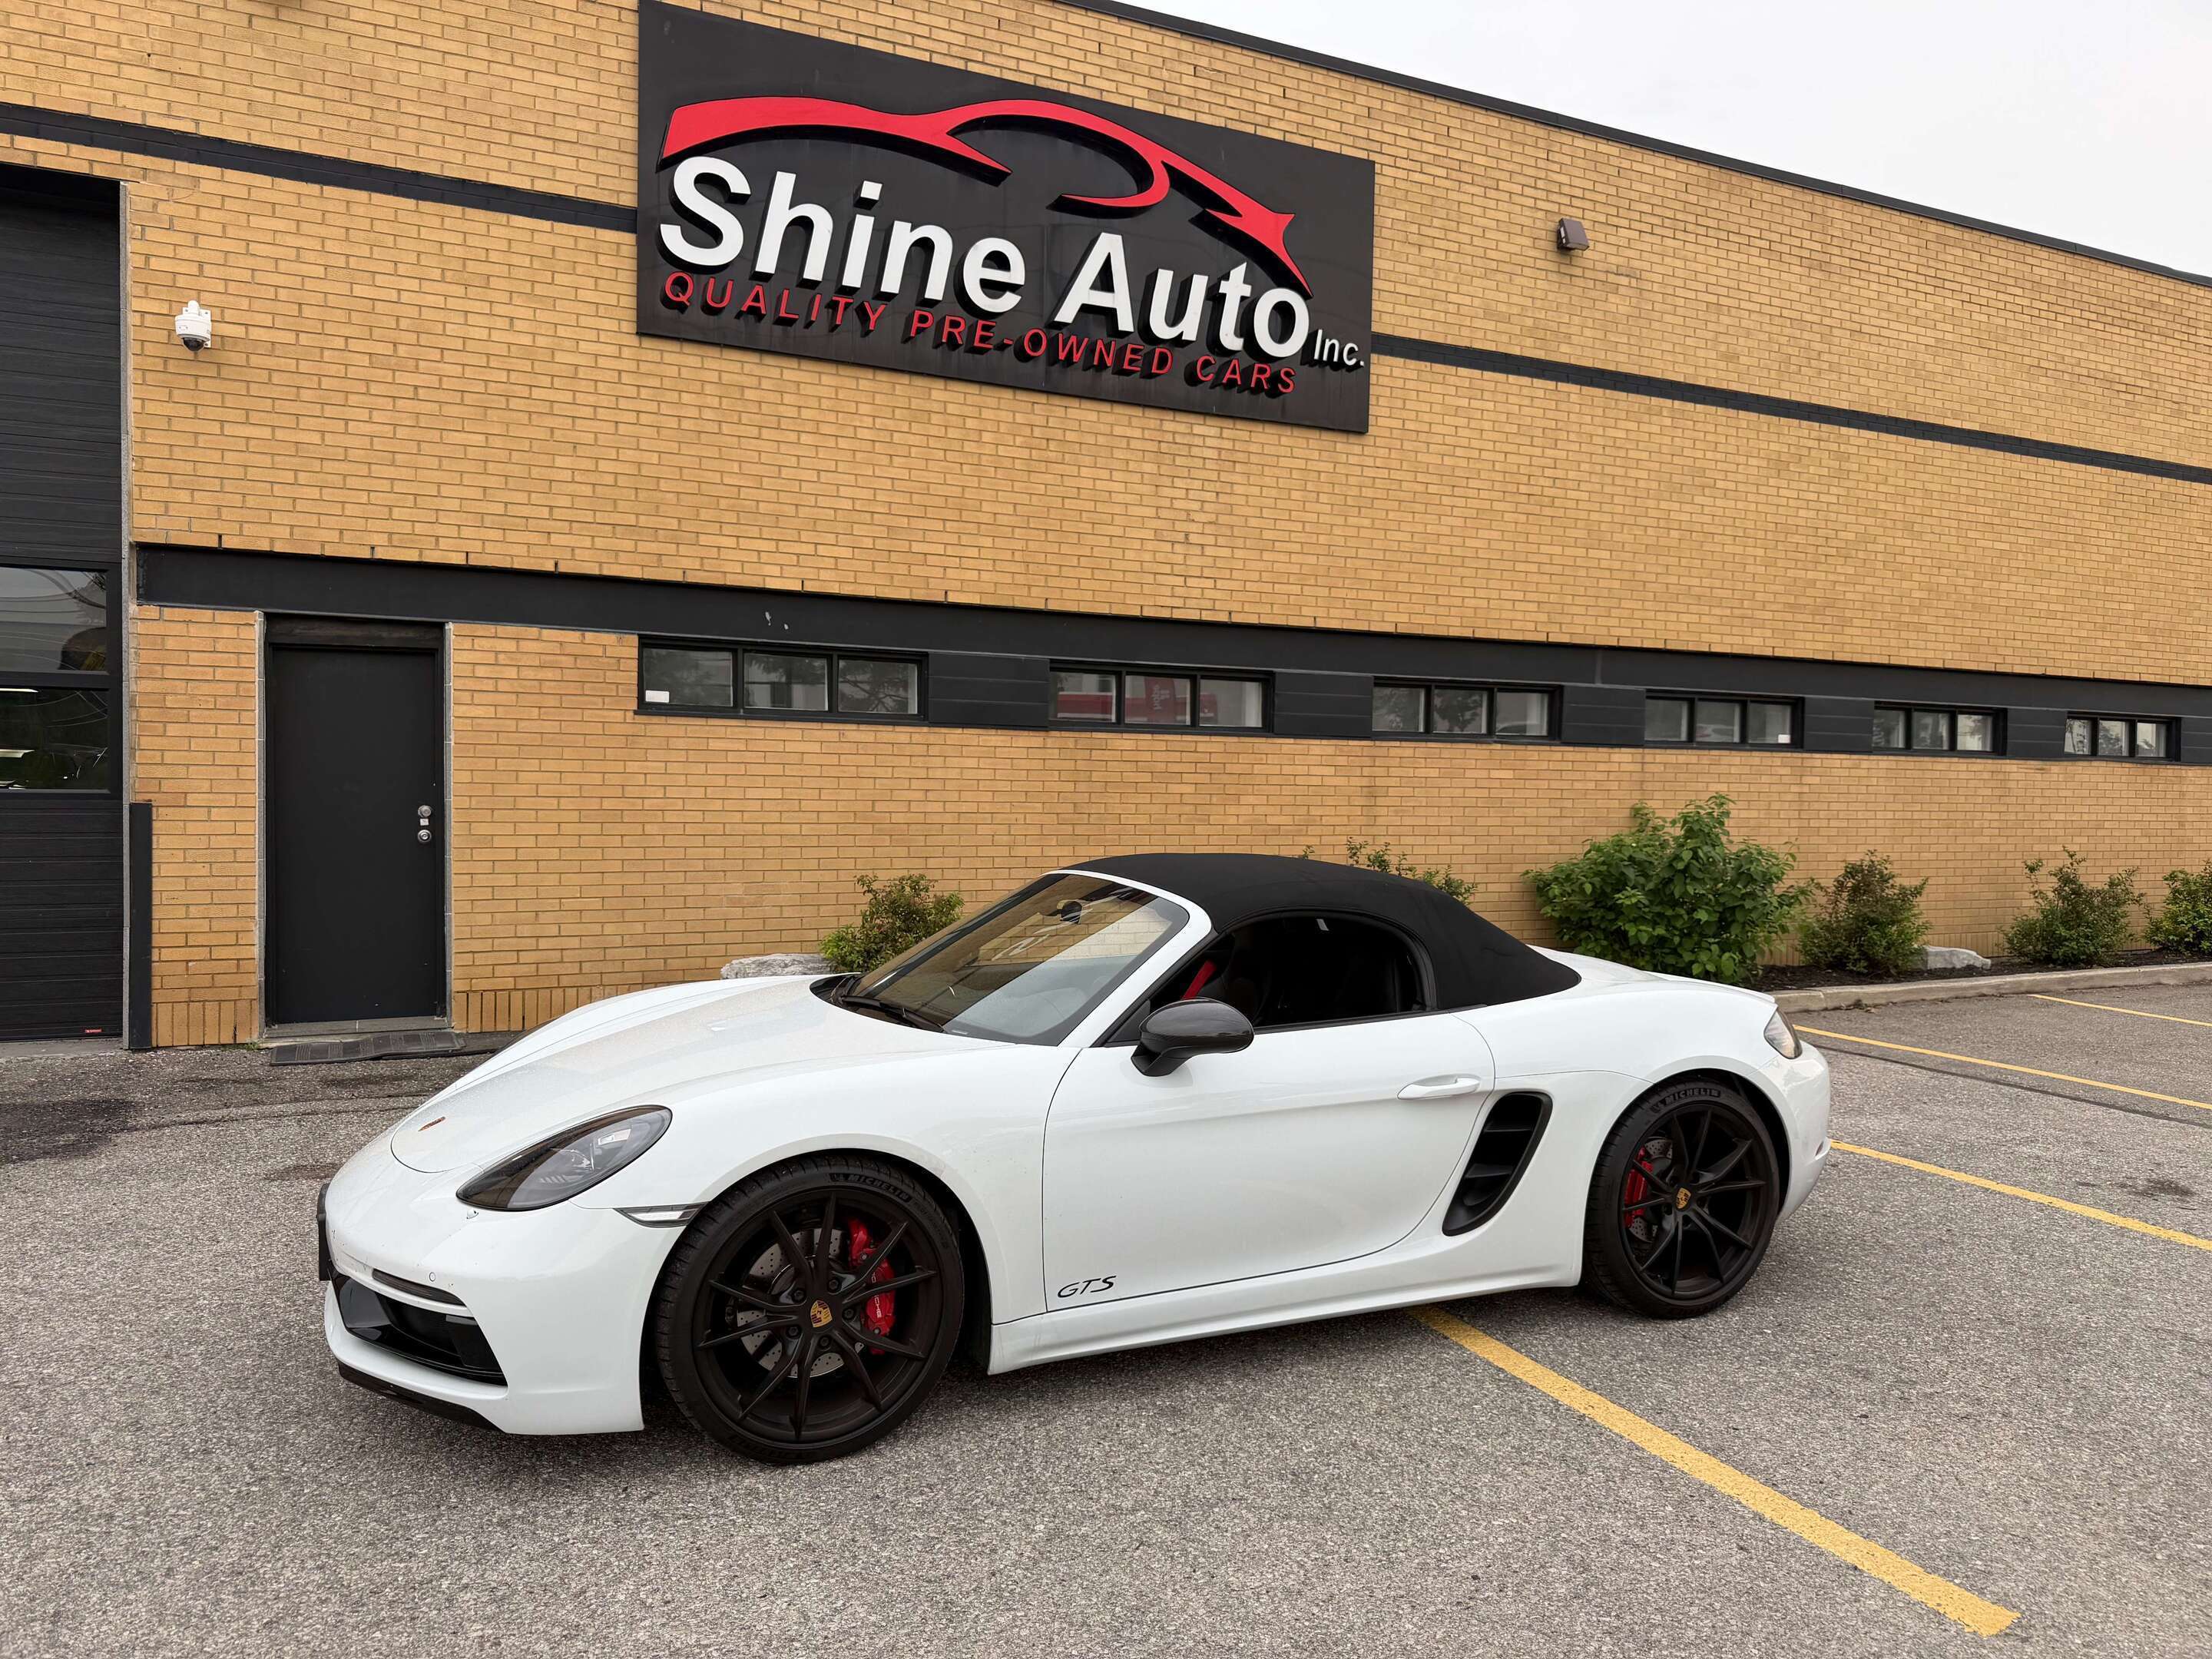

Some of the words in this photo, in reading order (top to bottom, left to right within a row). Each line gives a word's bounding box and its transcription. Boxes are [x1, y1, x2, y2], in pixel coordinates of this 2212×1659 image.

[660, 156, 1026, 313] Shine
[1054, 232, 1310, 357] Auto
[1314, 329, 1365, 367] Inc.
[665, 272, 887, 330] QUALITY
[909, 310, 1174, 375] PRE-OWNED
[1196, 356, 1296, 393] CARS
[847, 1173, 910, 1200] MICHELIN
[1058, 1275, 1117, 1298] GTS
